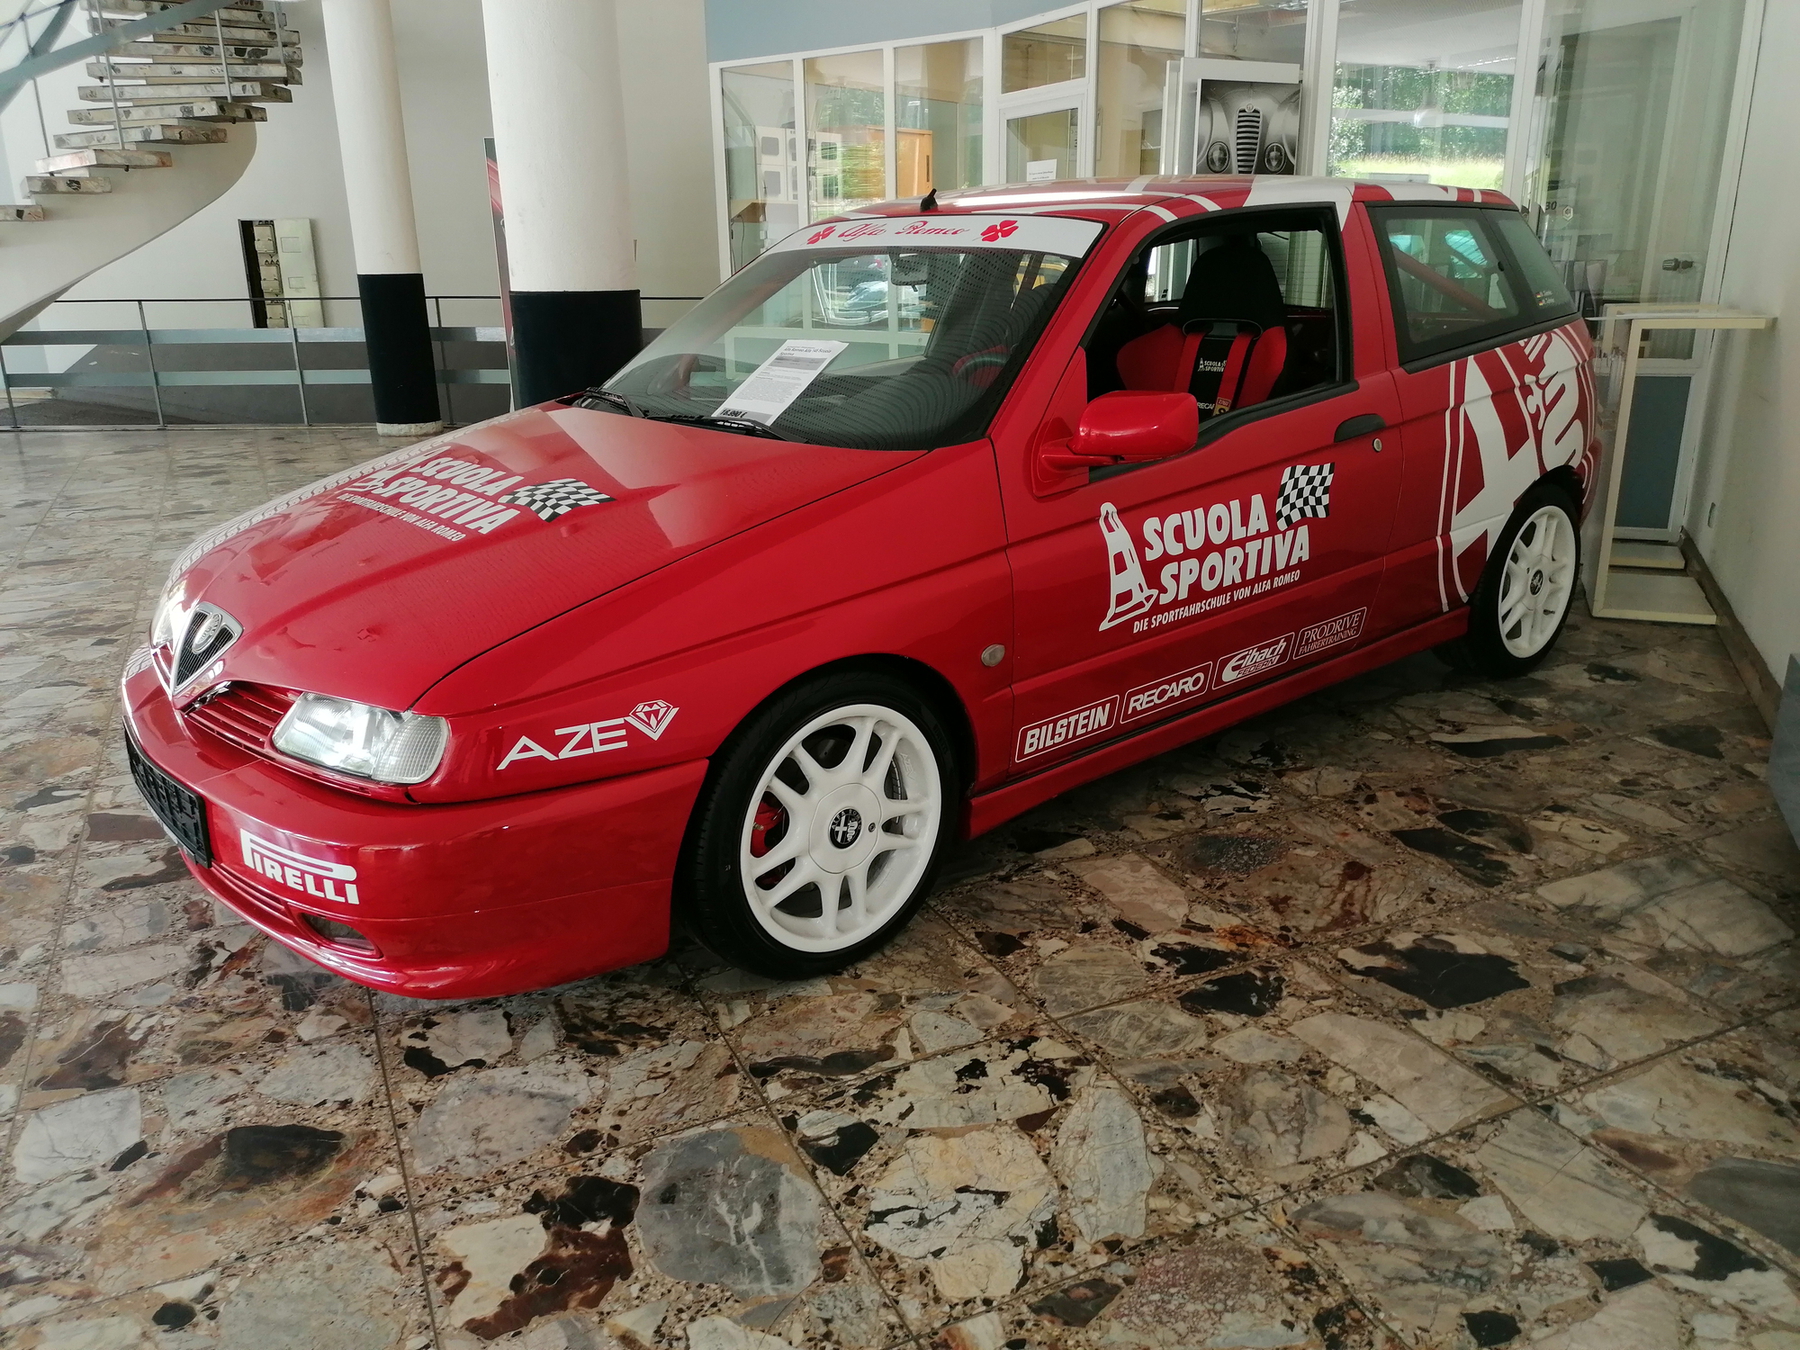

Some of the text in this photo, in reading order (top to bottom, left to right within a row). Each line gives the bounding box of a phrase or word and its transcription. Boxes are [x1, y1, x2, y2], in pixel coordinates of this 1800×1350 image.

[838, 220, 970, 243] Alfa Romeo
[409, 457, 524, 496] SCUOLA
[371, 476, 521, 534] SPORTIVA
[399, 512, 422, 523] VON
[413, 518, 438, 530] ALFA
[431, 525, 466, 541] ROMEO
[1143, 494, 1269, 561] SCUOLA
[1159, 525, 1310, 605] SPORTIVA
[1133, 570, 1301, 634] DIE SPORTFAHRSCHULE VON ALFA ROMEO
[1299, 627, 1358, 655] FAHRERTRAINING
[1301, 612, 1362, 646] PRODRIVE
[1221, 638, 1288, 683] Eibach
[1127, 672, 1205, 715] RECARO
[1023, 703, 1112, 755] BILSTEIN
[240, 828, 360, 905] PIRELLI
